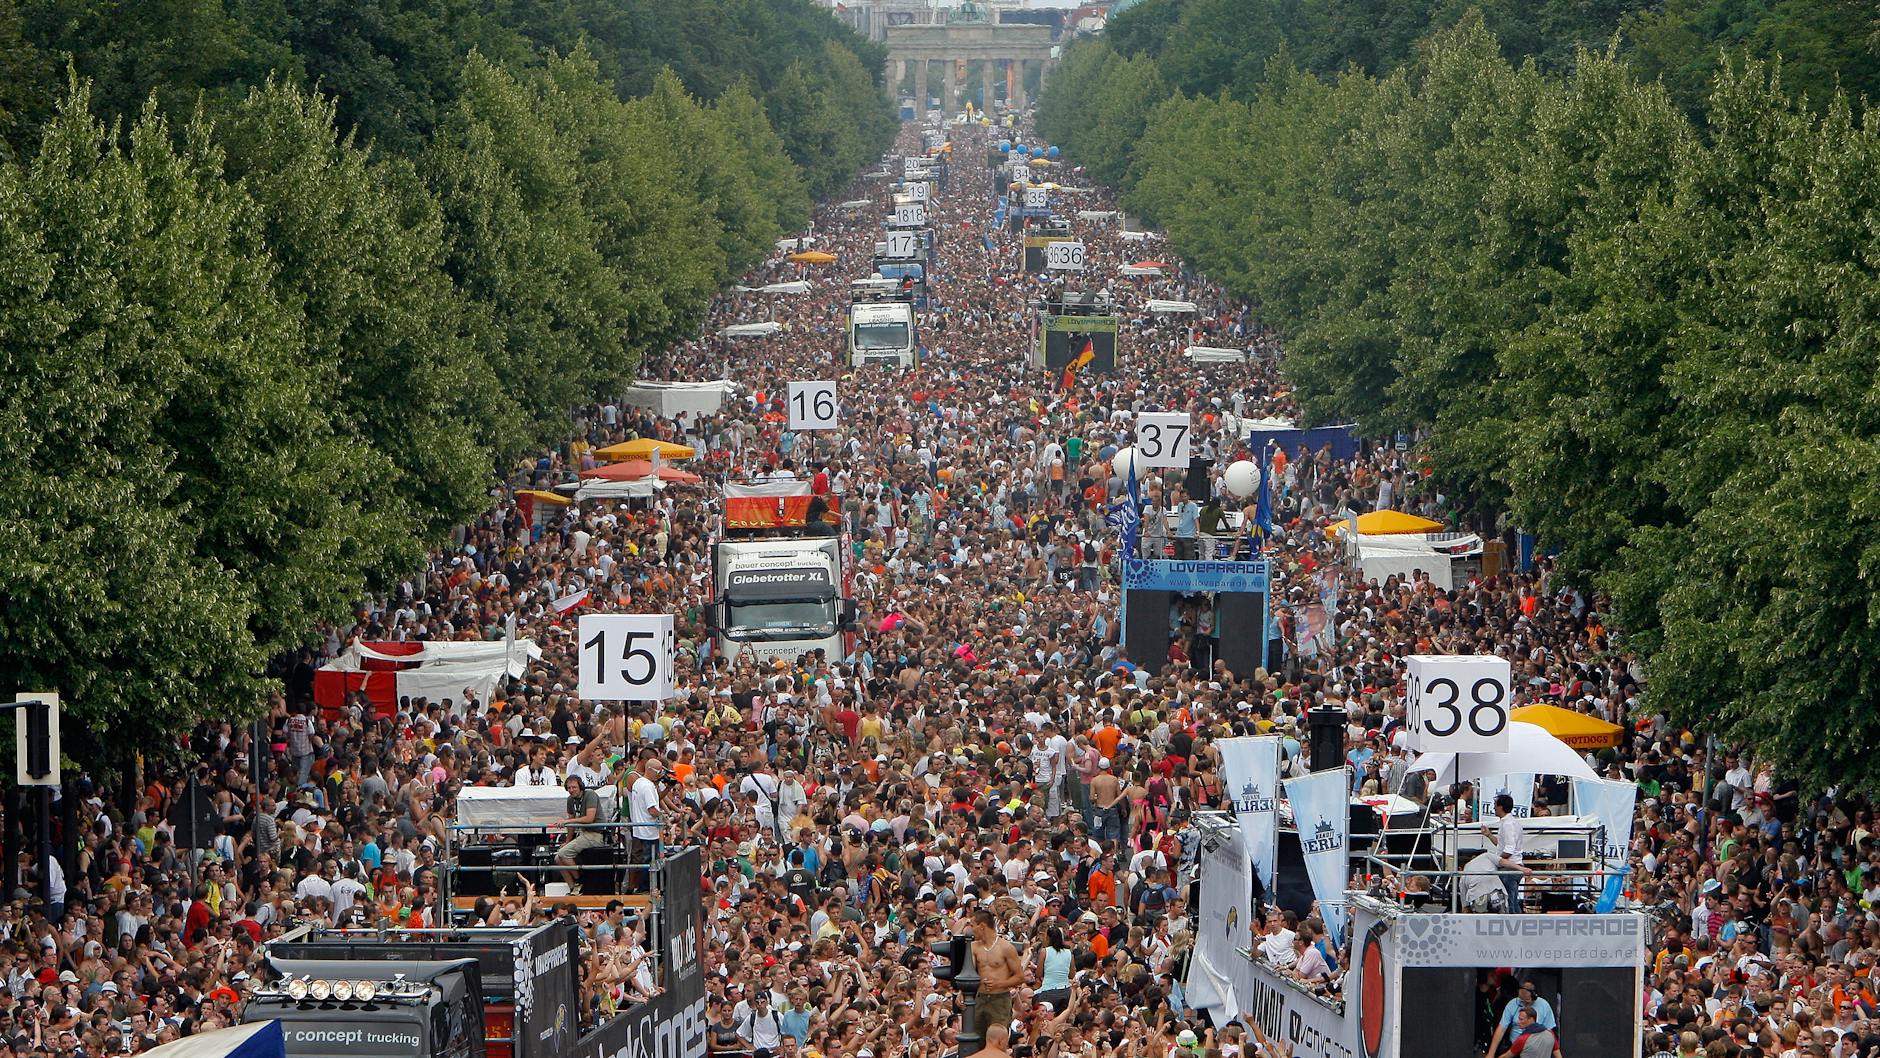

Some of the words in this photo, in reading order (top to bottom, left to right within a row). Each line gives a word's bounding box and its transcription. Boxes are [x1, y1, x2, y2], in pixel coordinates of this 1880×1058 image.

[906, 159, 919, 169] 20
[1014, 169, 1028, 178] 34
[909, 185, 925, 197] 19
[1029, 192, 1045, 204] 35
[896, 208, 909, 222] 18
[910, 208, 924, 222] 18
[890, 236, 911, 252] 17
[1048, 246, 1059, 263] 36
[1060, 247, 1082, 264] 36
[792, 389, 834, 421] 16
[1139, 423, 1189, 458] 37
[759, 560, 794, 568] concept
[1169, 562, 1265, 574] LOVEPARADE
[733, 573, 805, 585] Globetrotter
[807, 572, 824, 581] XL
[1169, 579, 1265, 588] www.loveparade.net
[584, 630, 657, 686] 15
[1423, 677, 1507, 737] 38
[1564, 735, 1609, 745] HOTDOGS
[1476, 918, 1639, 937] LOVEPARADE
[1476, 946, 1640, 962] www.loveparade.net
[295, 1028, 363, 1046] concept
[367, 1031, 420, 1047] trucking
